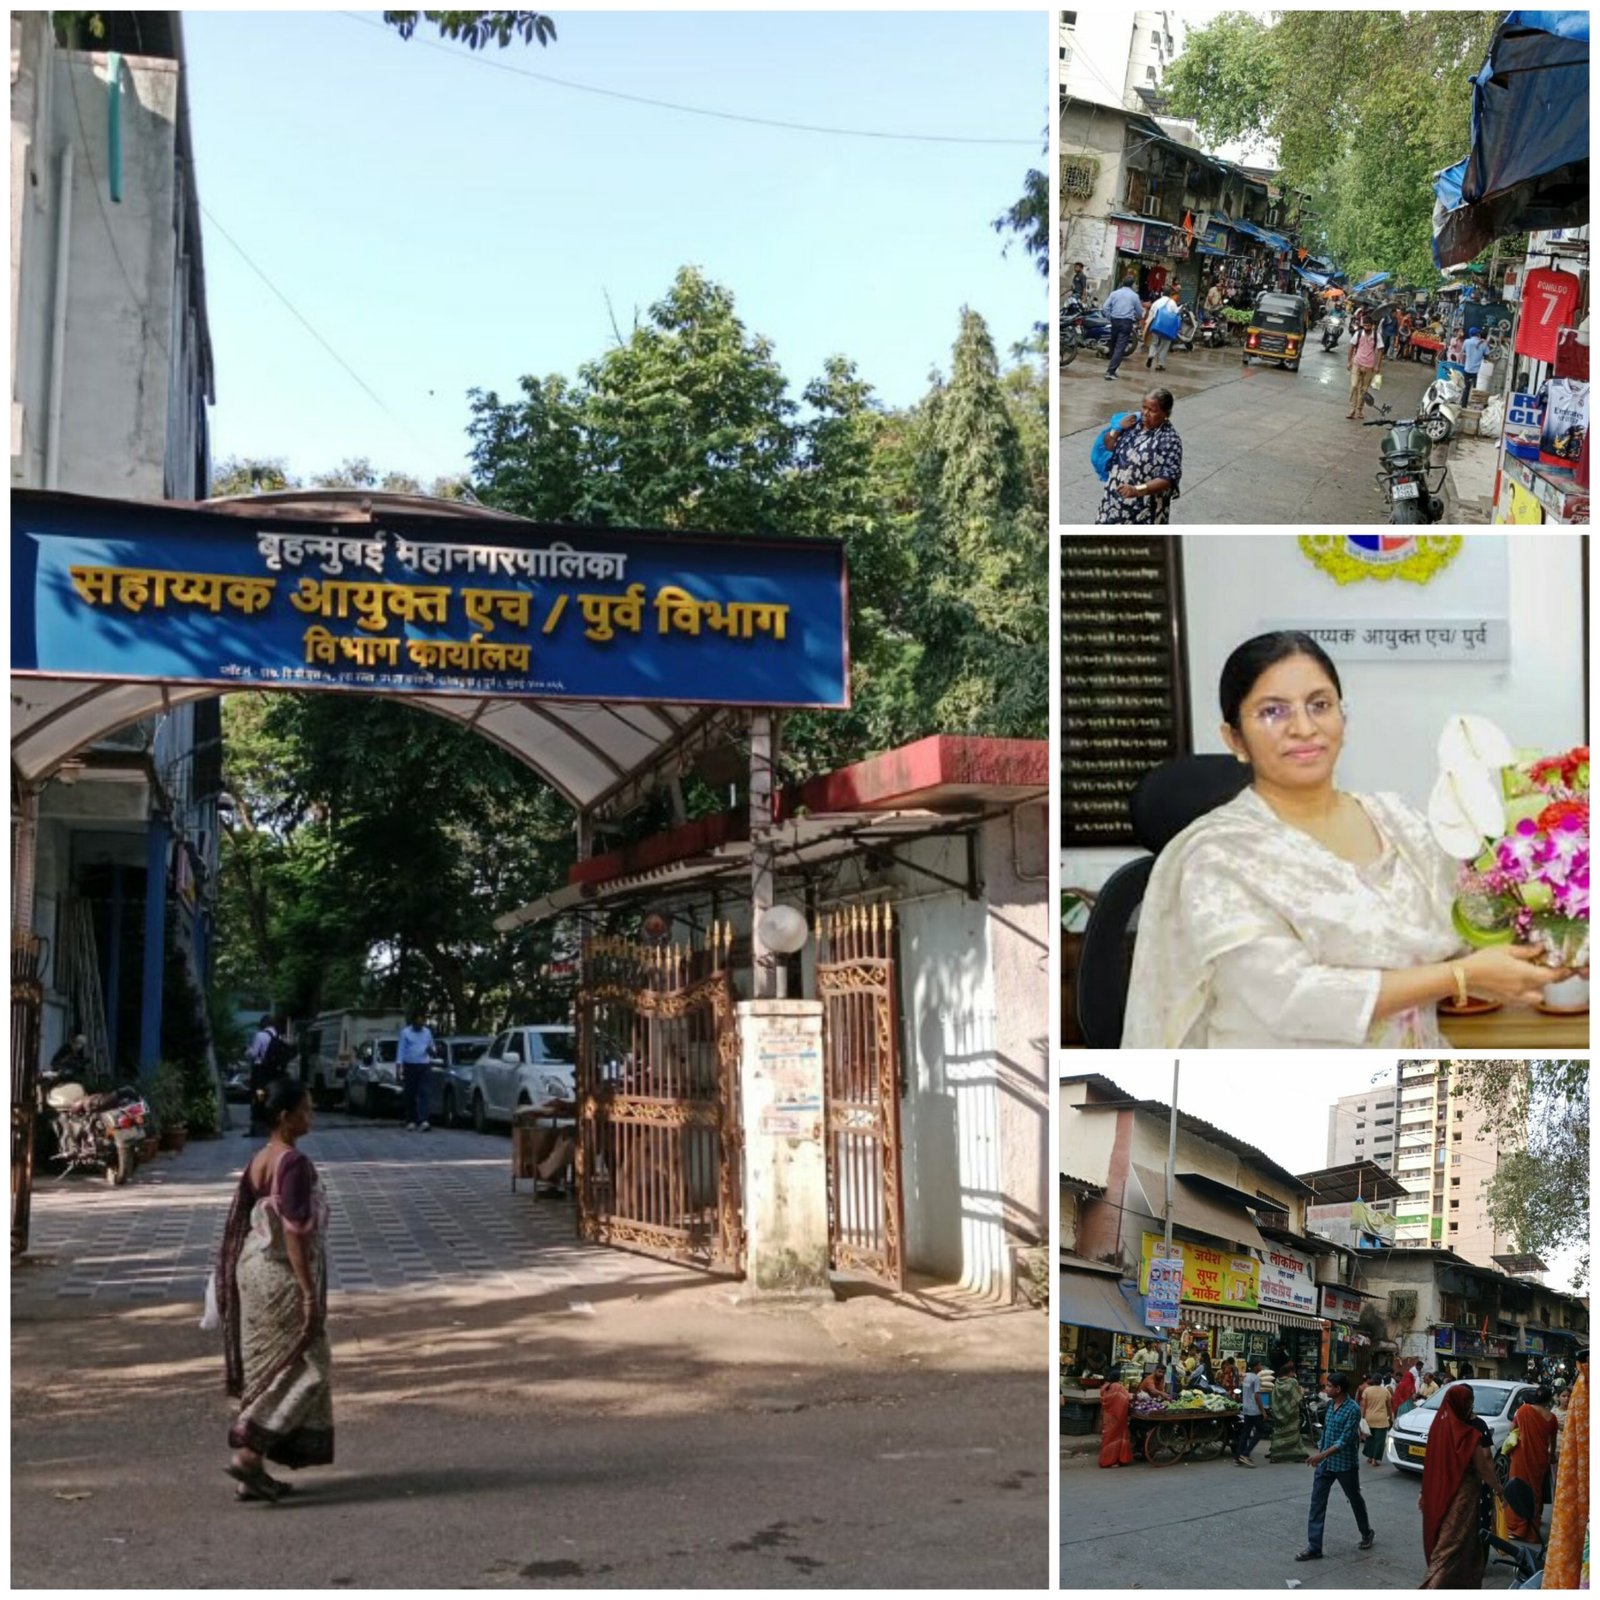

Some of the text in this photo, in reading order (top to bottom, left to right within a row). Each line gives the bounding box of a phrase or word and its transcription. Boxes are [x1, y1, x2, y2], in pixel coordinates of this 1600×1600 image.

[1537, 281, 1568, 294] RONALDO
[1540, 293, 1559, 325] 7
[257, 527, 627, 581] बृहन्मुंबई महानगरपालिका
[69, 564, 277, 614] सहाय्यक
[290, 577, 451, 631] आयुक्त
[461, 586, 533, 633] एच
[578, 583, 645, 641] पुर्व
[654, 585, 790, 640] विभाग
[303, 625, 532, 673] विभाग कार्यालय
[1362, 627, 1421, 650] आयुक्त
[1462, 621, 1488, 650] पुर्व
[1194, 1248, 1222, 1265] जयेश
[1270, 1248, 1304, 1274] लोकप्रिय
[1196, 1268, 1219, 1286] सुपर
